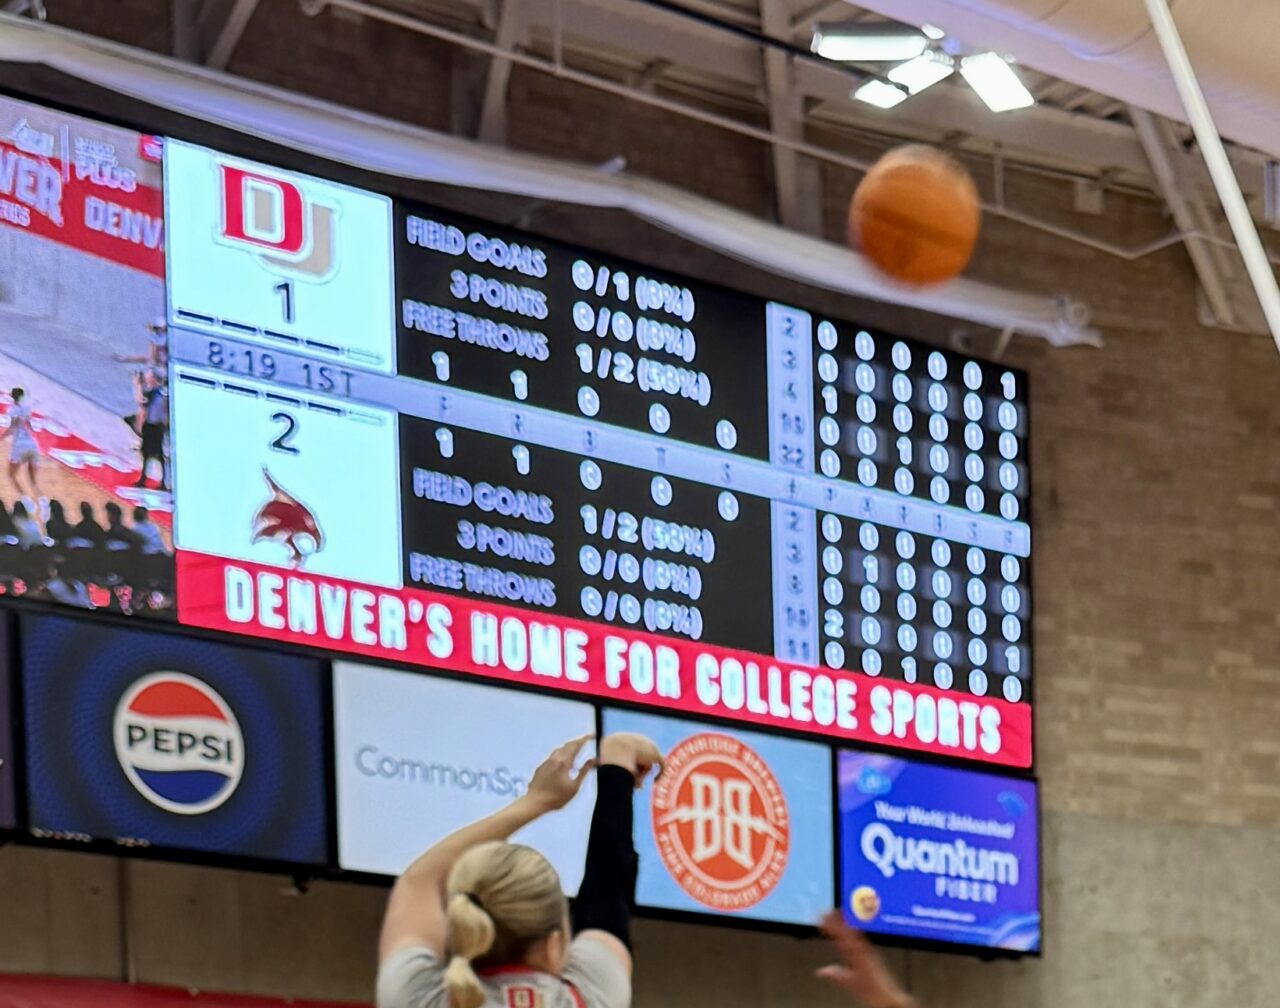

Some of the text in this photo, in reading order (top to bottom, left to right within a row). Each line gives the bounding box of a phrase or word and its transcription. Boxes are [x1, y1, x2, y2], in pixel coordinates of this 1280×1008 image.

[467, 232, 548, 278] GOALS
[275, 281, 295, 323] 1
[450, 269, 469, 299] 3
[469, 274, 549, 320] POINTS
[402, 299, 455, 339] FREE
[455, 311, 549, 362] THROWS
[208, 341, 357, 395] 8:19 1ST
[432, 352, 450, 381] 1
[510, 370, 528, 400] 1
[1000, 371, 1016, 401] 1
[821, 385, 838, 414] 1
[270, 413, 300, 455] 2
[435, 427, 454, 458] 1
[512, 445, 530, 475] 1
[896, 436, 913, 465] 1
[473, 481, 554, 524] GOALS
[456, 519, 476, 549] 3
[476, 522, 555, 566] POINTS
[409, 552, 463, 590] FREE
[462, 562, 557, 607] THROWS
[862, 554, 879, 584] 1
[225, 566, 1002, 755] DENVER'S HOME FOR COLLEGE SPORTS
[824, 608, 844, 638] 2
[1004, 645, 1021, 673] 1
[900, 656, 917, 684] 1
[127, 724, 234, 762] PEPSI
[354, 744, 528, 798] CommonSp
[861, 822, 1019, 886] Quantum
